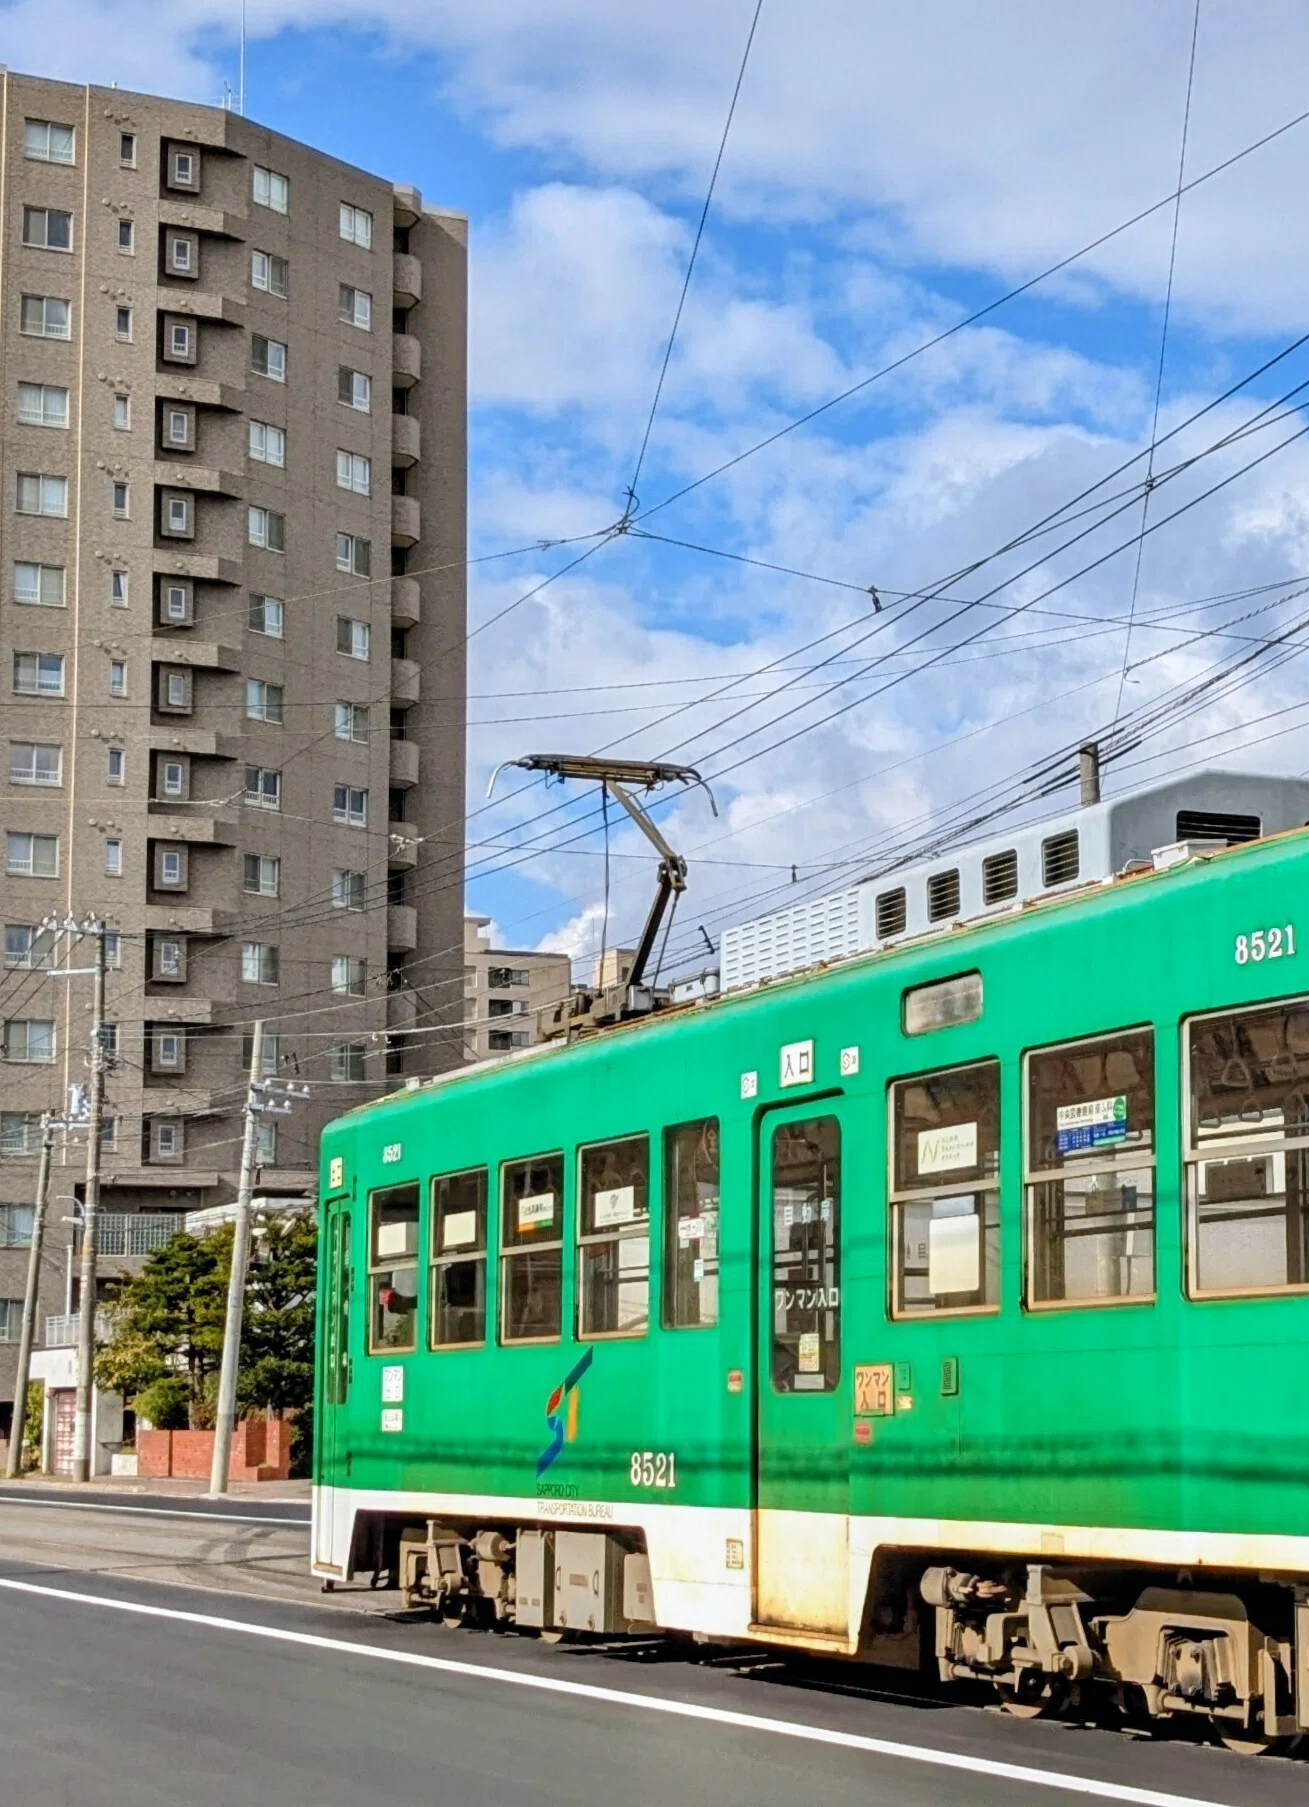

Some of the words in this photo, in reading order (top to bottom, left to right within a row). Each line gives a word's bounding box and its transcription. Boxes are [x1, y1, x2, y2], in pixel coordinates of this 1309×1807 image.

[1235, 924, 1295, 965] 8521
[784, 1051, 809, 1079] 入口
[774, 1287, 839, 1311] ワンマン入口
[856, 1370, 889, 1388] ワンマン
[861, 1391, 886, 1410] 入口
[630, 1452, 676, 1488] 8521
[536, 1482, 564, 1497] SAPPORO
[537, 1501, 588, 1517] TRANSPORTATION
[588, 1503, 614, 1519] BUREAU
